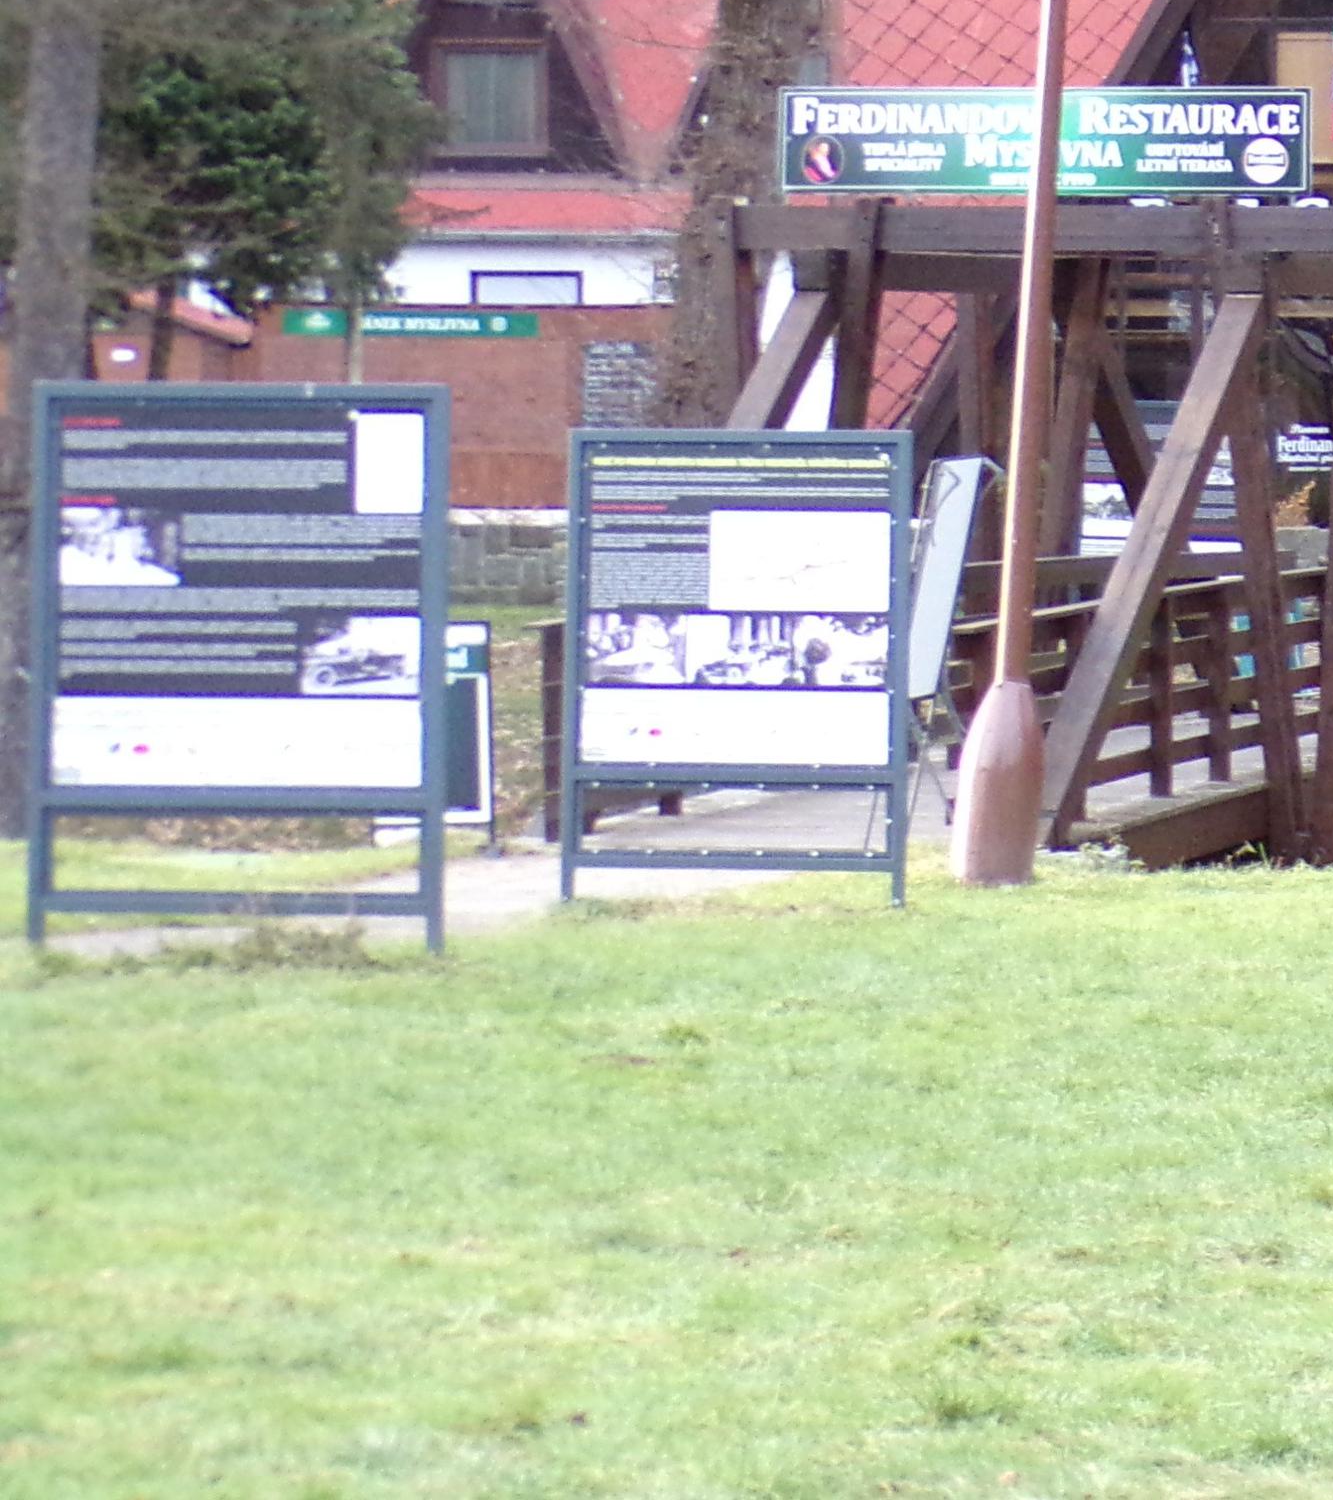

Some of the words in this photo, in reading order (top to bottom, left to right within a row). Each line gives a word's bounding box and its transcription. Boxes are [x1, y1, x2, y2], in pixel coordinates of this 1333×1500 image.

[792, 97, 1038, 135] FERDINANDOV
[1079, 97, 1300, 135] RESTAURACE
[964, 133, 1124, 168] MYSVNA
